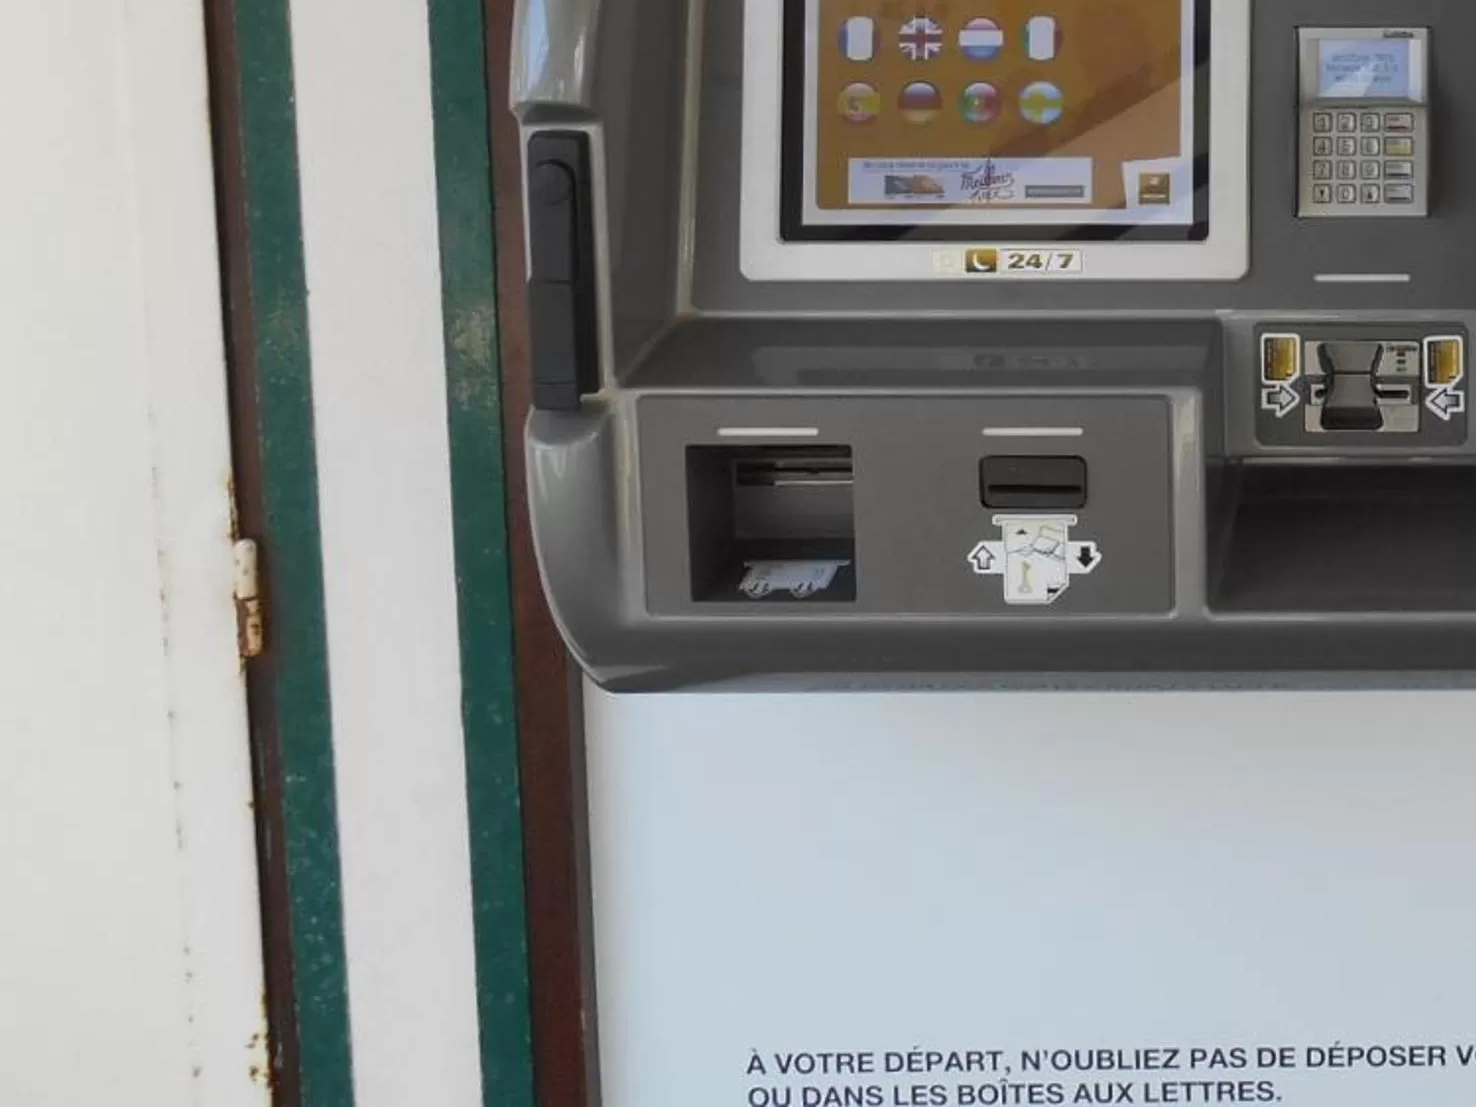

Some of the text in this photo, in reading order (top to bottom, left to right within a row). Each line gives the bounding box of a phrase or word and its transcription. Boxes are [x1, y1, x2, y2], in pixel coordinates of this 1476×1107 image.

[1007, 253, 1074, 271] 24/7
[747, 1049, 766, 1075] À
[775, 1052, 874, 1074] VOTRE
[885, 1046, 1010, 1075] DÉPART,
[1022, 1049, 1180, 1071] N'OUBLIEZ
[1191, 1048, 1247, 1069] PAS
[1257, 1047, 1295, 1068] DE
[1307, 1041, 1445, 1067] DÉPOSER
[748, 1078, 1281, 1107] OU DANS LES BOÎTES AUX LETTRES.
